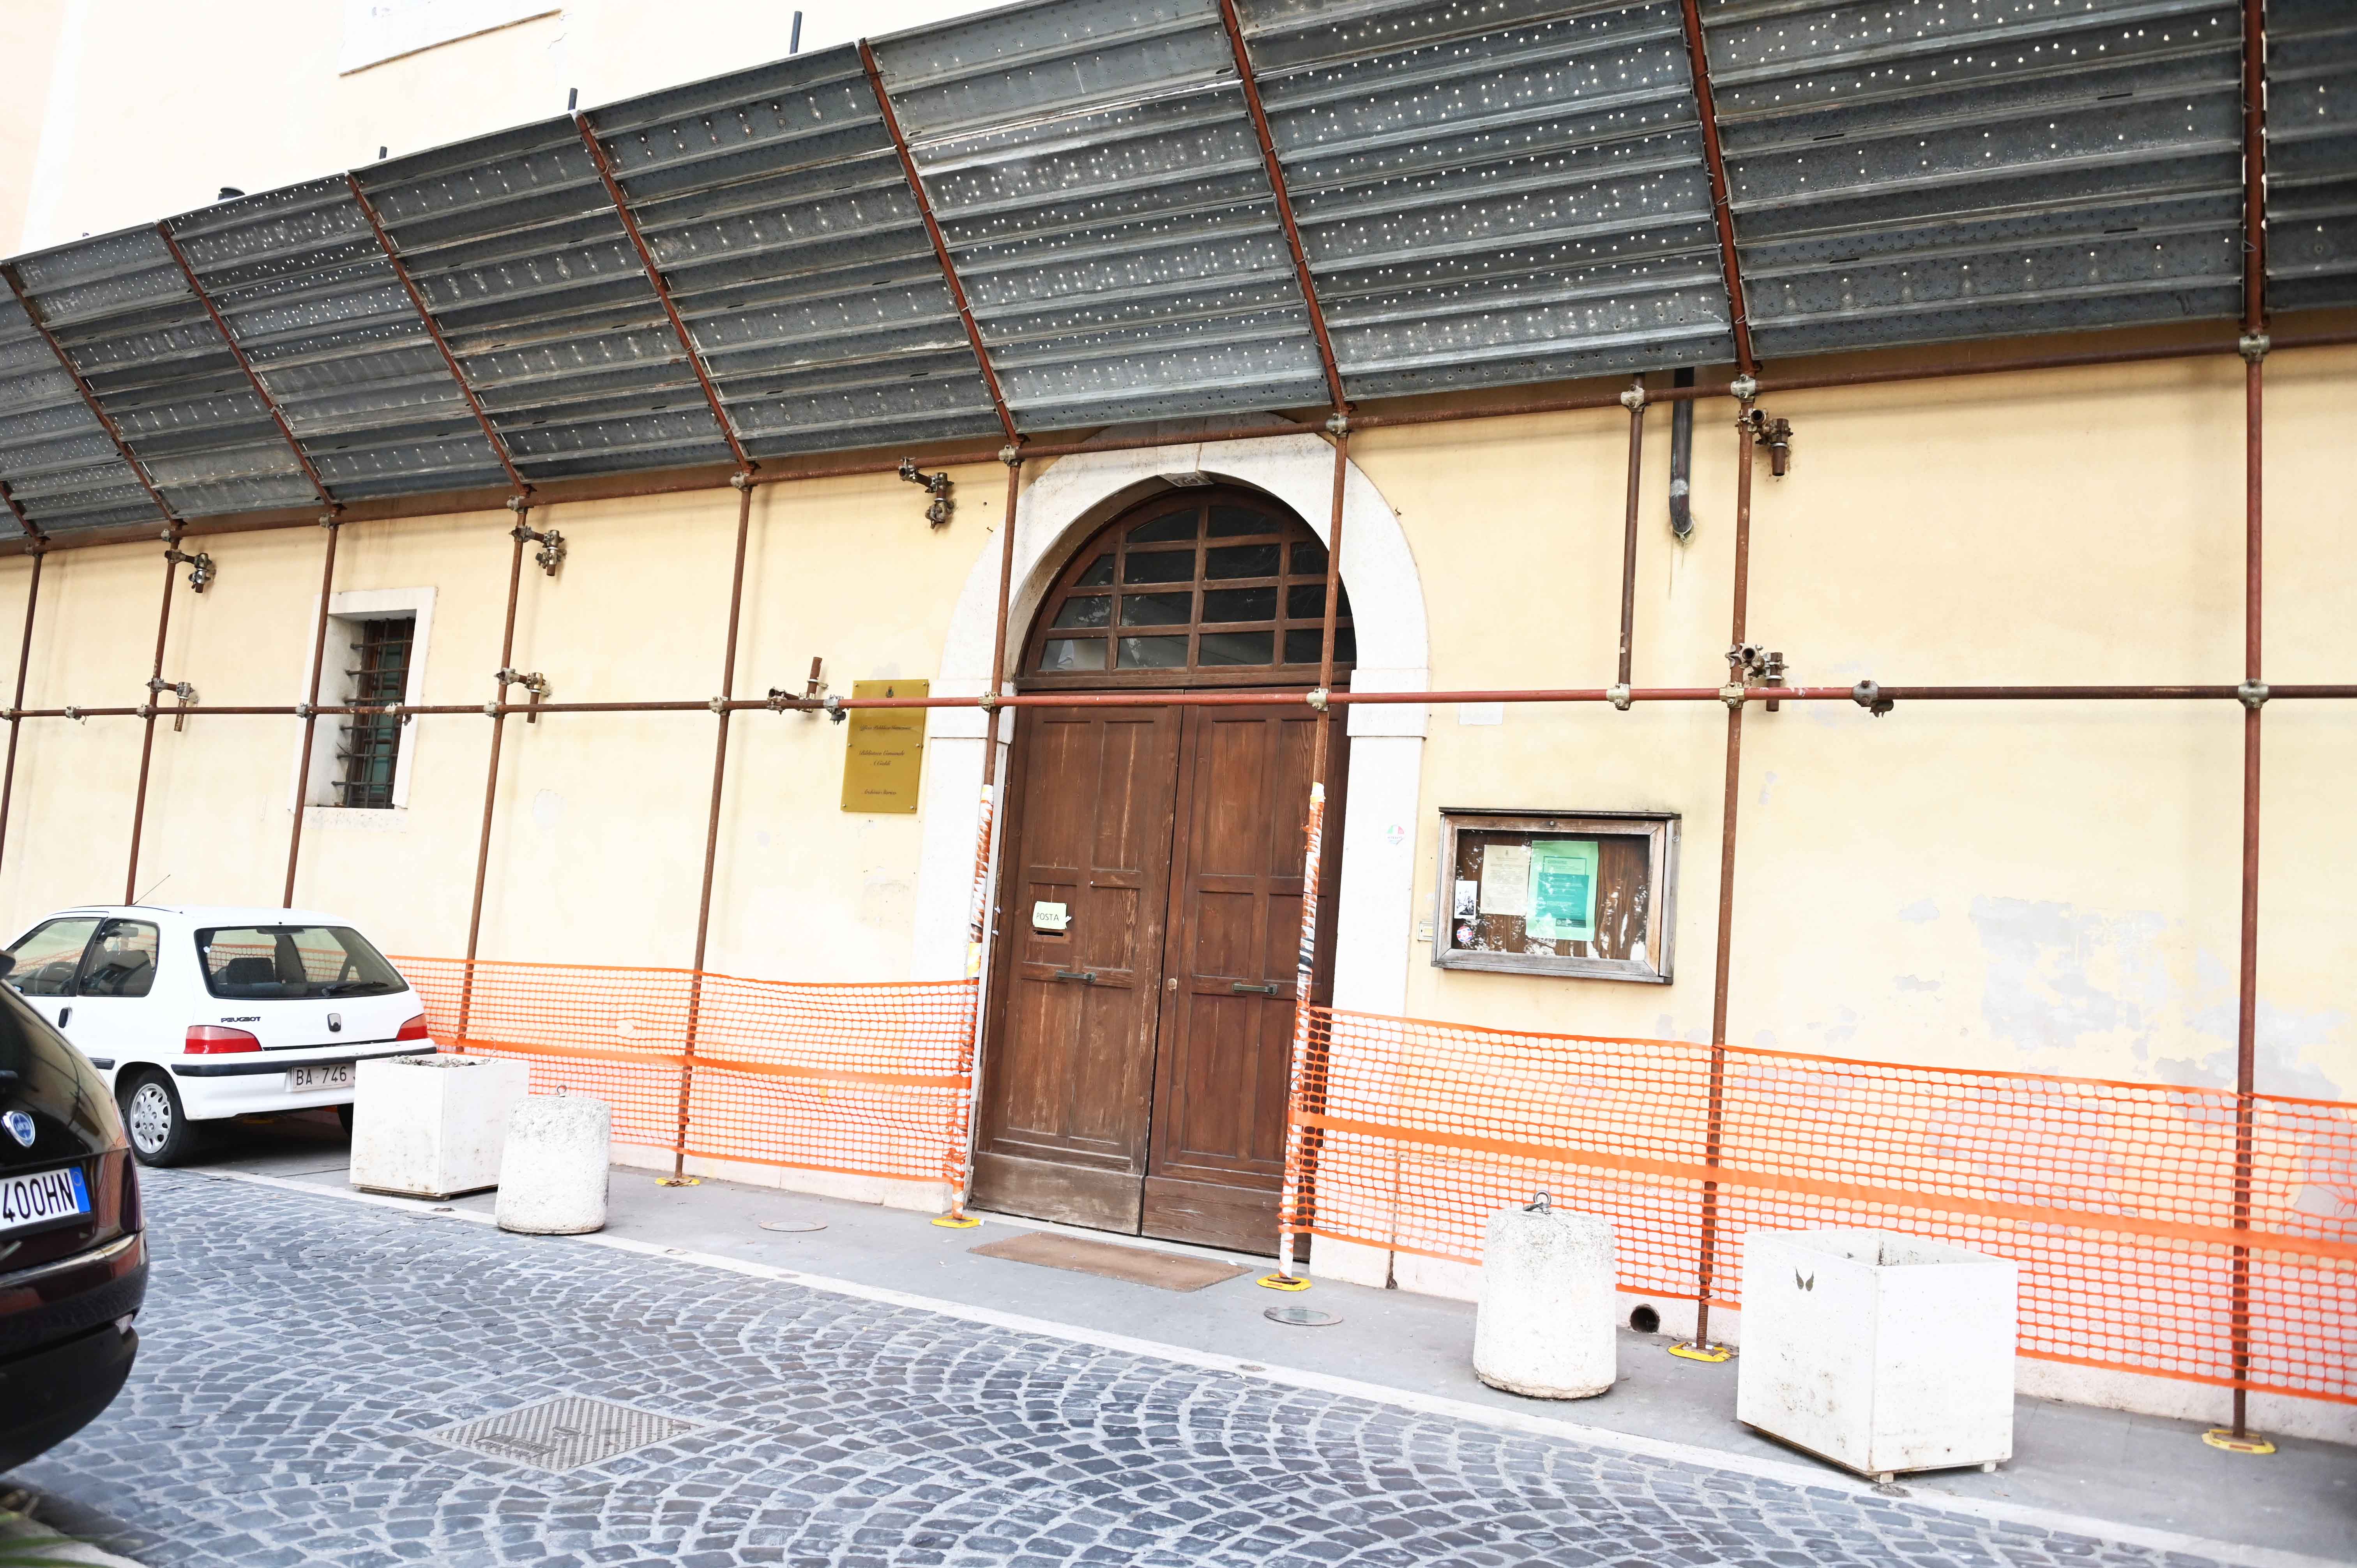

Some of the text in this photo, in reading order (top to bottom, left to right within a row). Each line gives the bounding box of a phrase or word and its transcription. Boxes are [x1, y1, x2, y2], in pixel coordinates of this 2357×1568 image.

[1036, 912, 1059, 921] POSTA
[297, 1066, 346, 1085] BA 746
